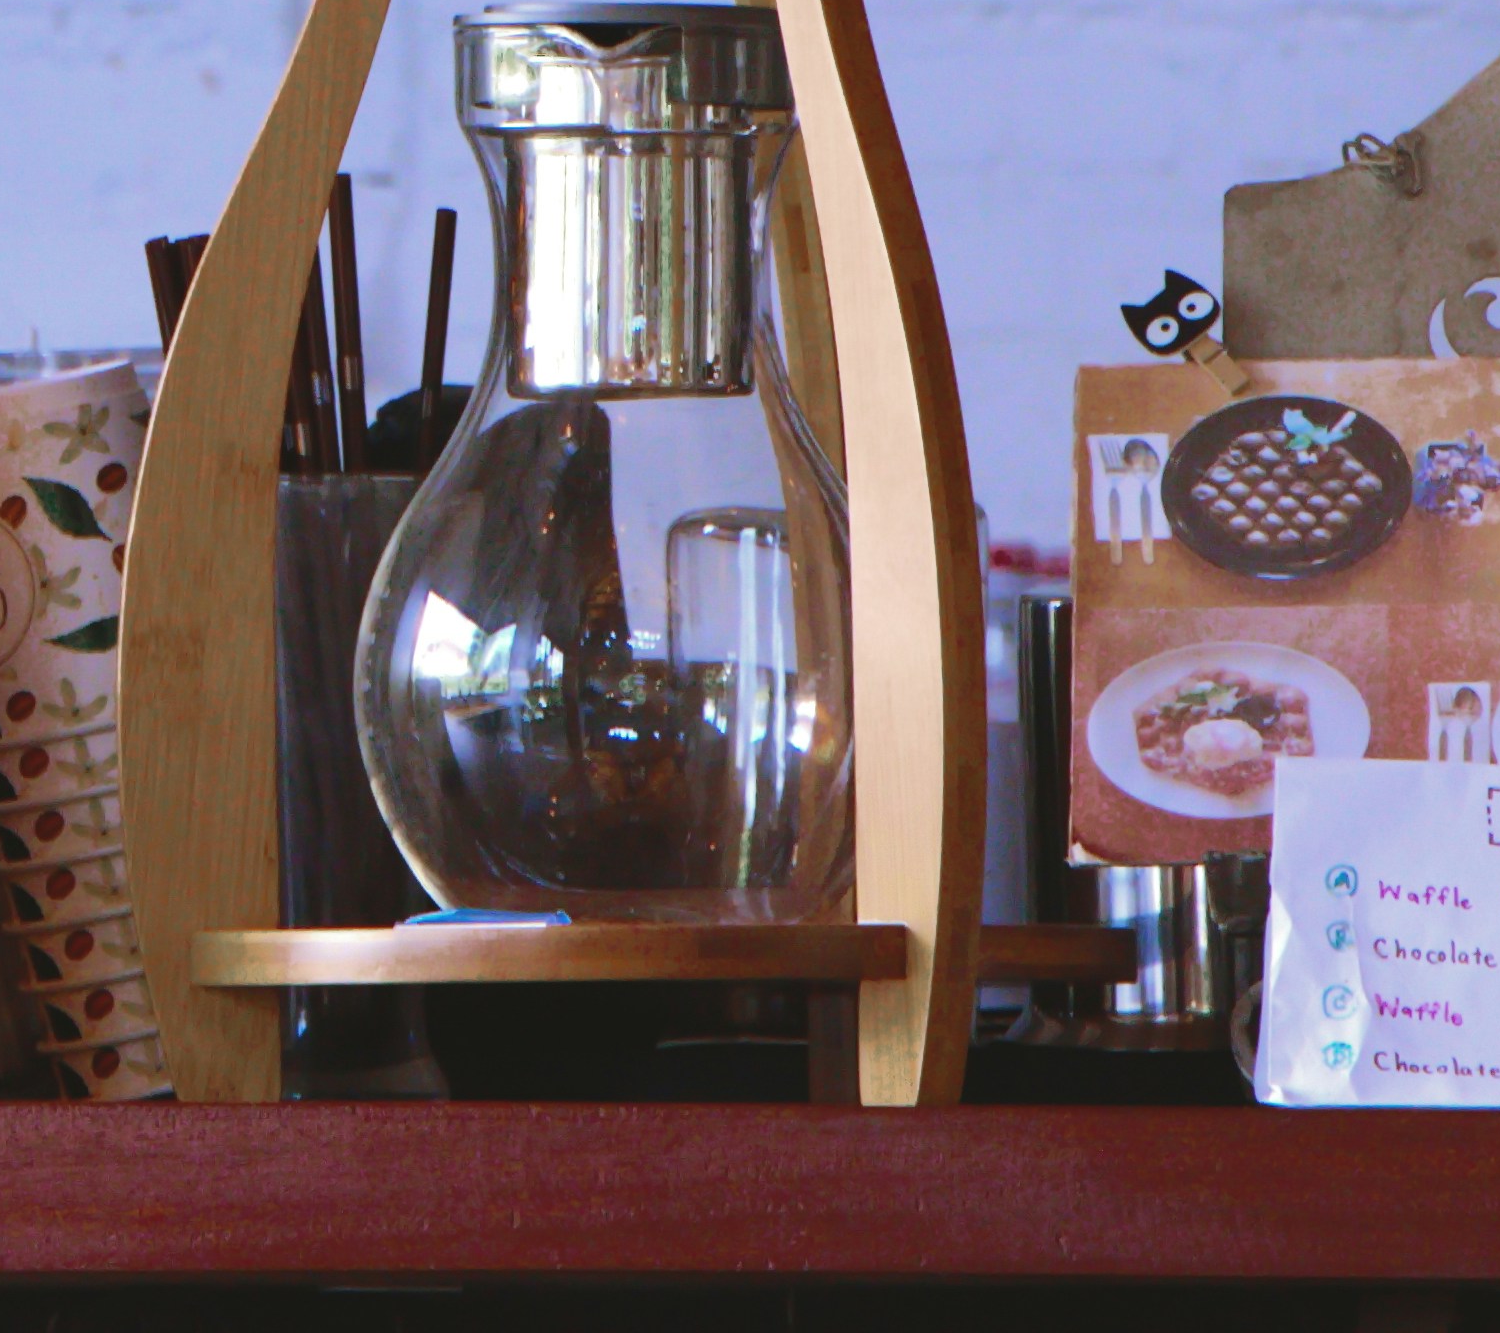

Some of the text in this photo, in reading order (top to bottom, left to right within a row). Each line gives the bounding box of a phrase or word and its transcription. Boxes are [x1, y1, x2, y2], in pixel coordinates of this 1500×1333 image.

[1378, 880, 1473, 910] Waffle
[1373, 938, 1498, 969] Chocolate
[1374, 992, 1463, 1027] Waffle
